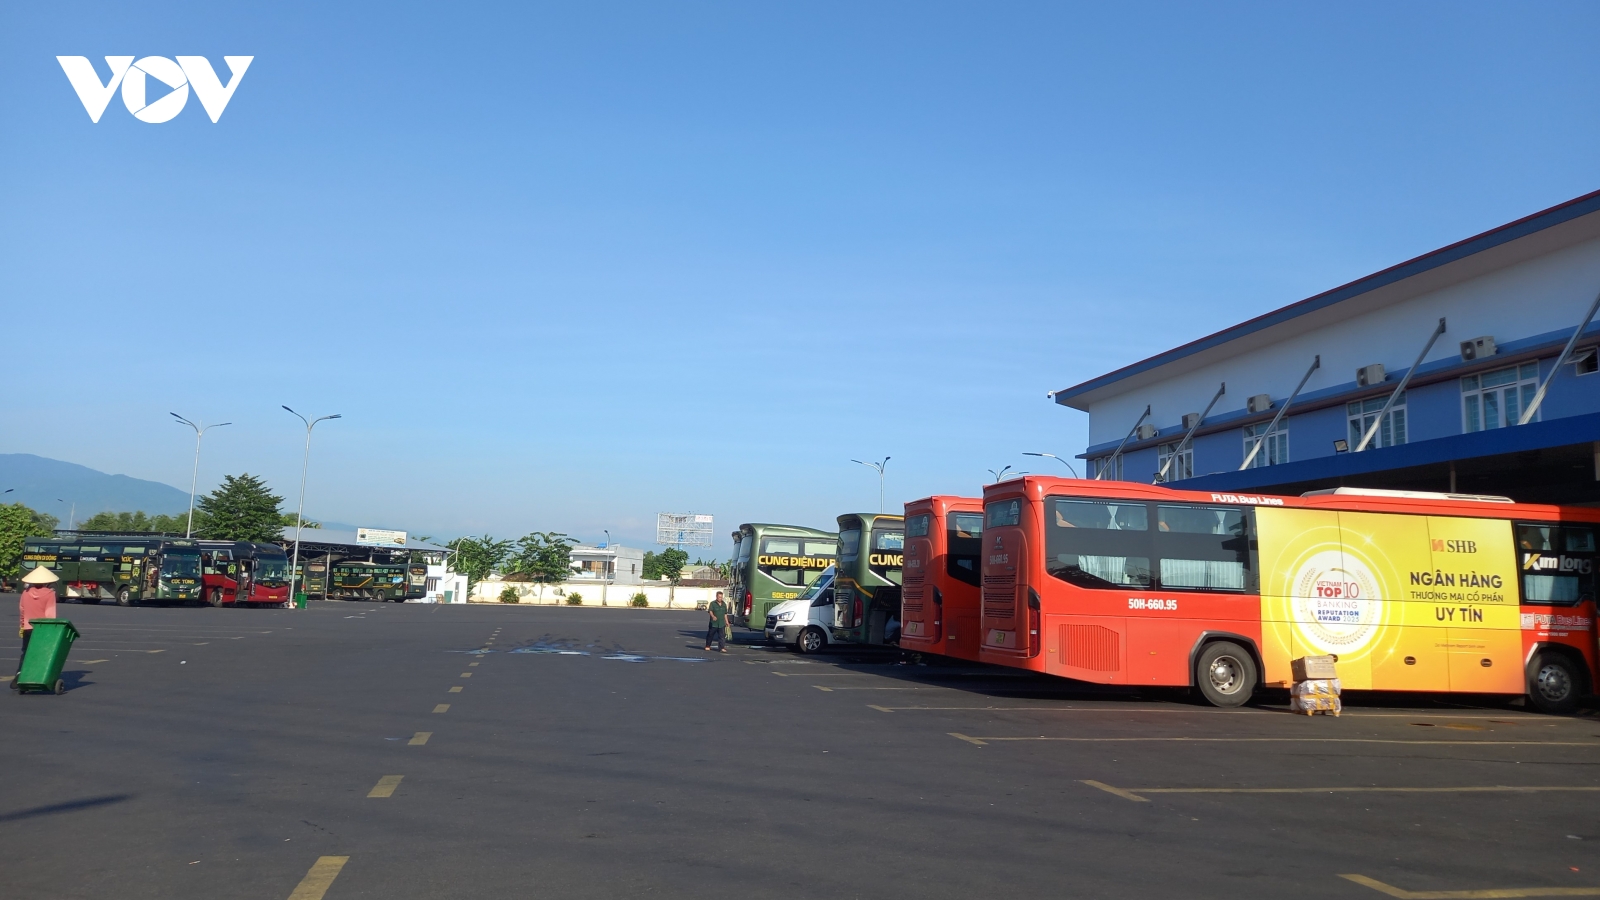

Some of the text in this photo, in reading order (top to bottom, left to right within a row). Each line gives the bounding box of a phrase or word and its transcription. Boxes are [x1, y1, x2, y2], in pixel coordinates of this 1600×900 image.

[1211, 493, 1284, 505] FUTA Bus Lines
[1446, 539, 1477, 553] SHB
[758, 555, 789, 566] CUNG
[790, 555, 815, 569] ĐIỆN
[816, 558, 828, 568] DI
[1523, 553, 1592, 575] Kim Long
[1410, 569, 1503, 589] NGÂN HÀNG
[1316, 582, 1360, 599] TOP 10
[1410, 590, 1448, 600] THƯƠNG
[1449, 592, 1465, 603] MẠI
[1128, 598, 1178, 610] 50H-660.95
[1317, 600, 1358, 609] BANKING
[1435, 604, 1483, 622] UY TÍN
[1534, 613, 1556, 625] FUTA
[1556, 614, 1572, 626] Bus
